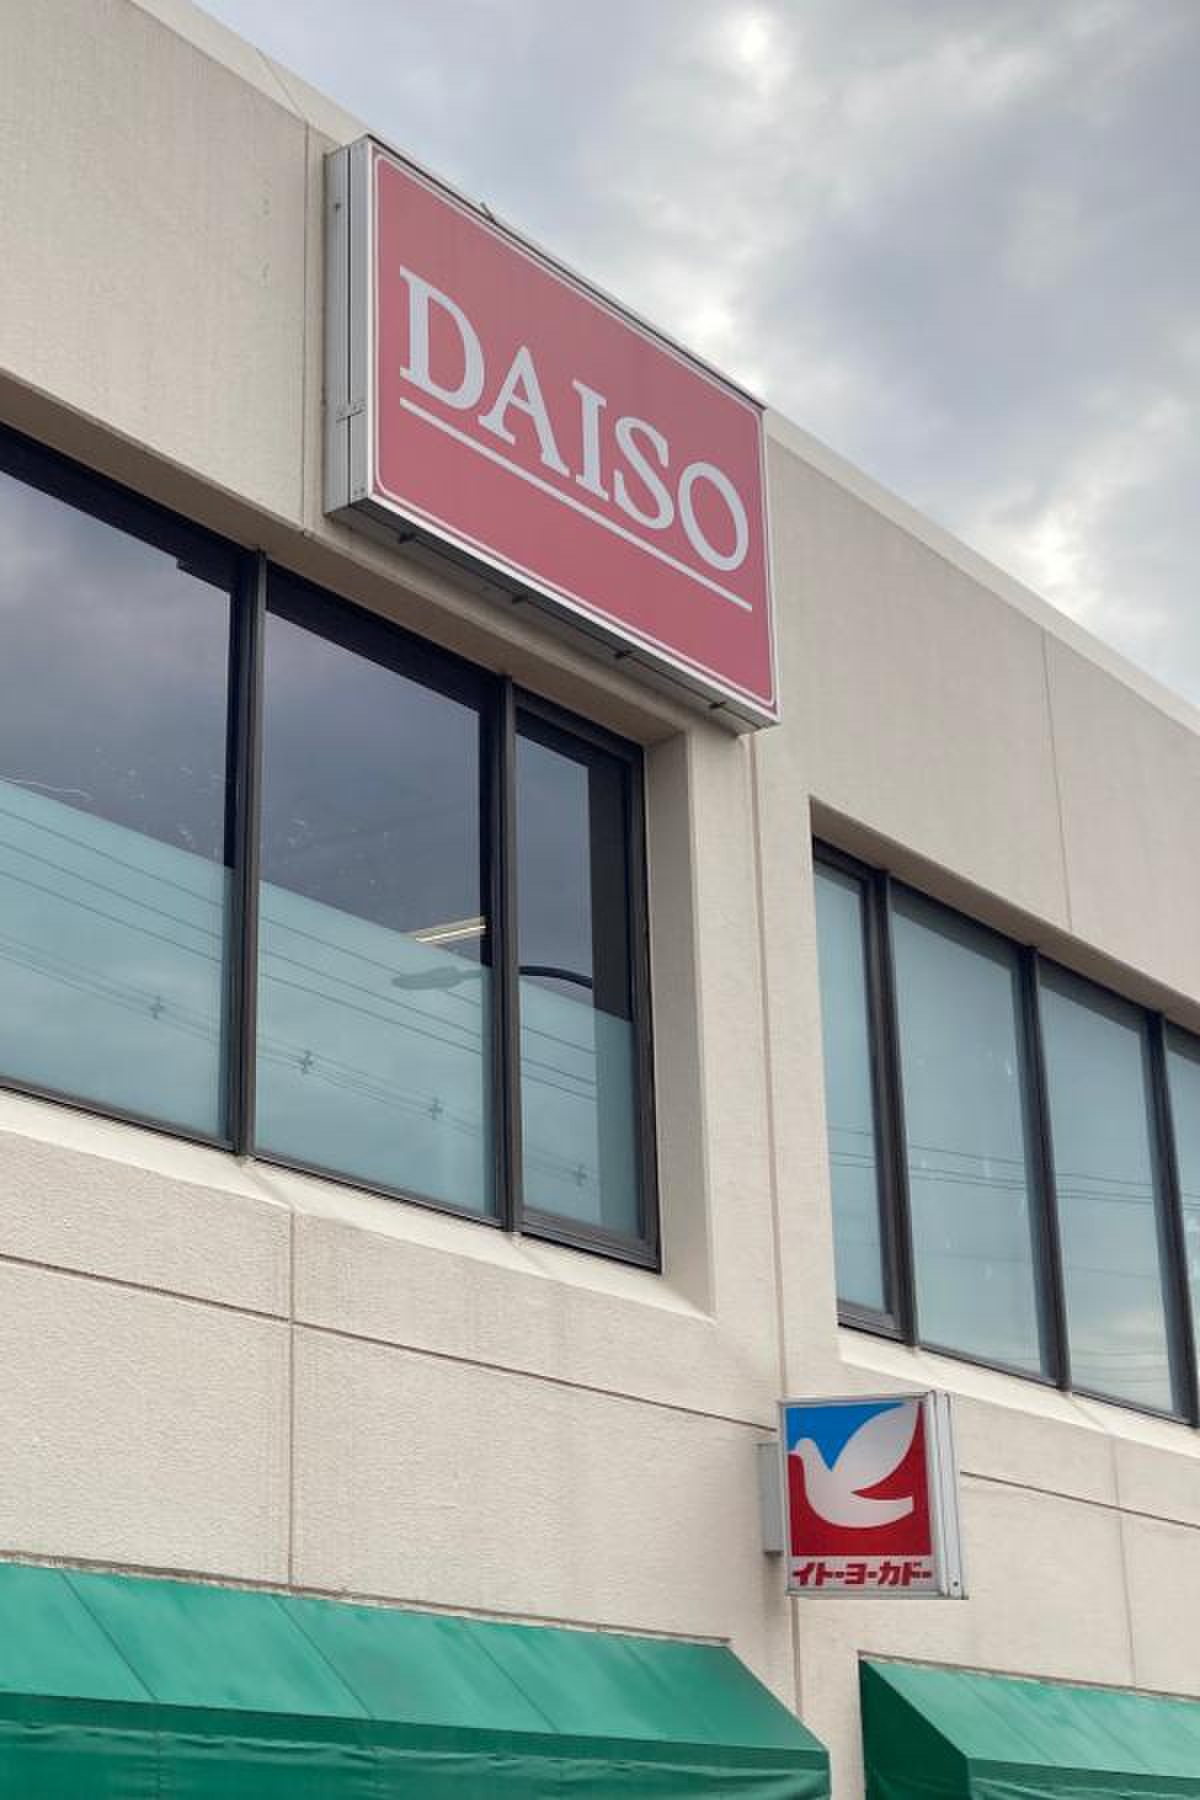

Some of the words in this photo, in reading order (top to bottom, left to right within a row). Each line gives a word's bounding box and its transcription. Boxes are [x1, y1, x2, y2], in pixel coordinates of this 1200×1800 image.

[399, 264, 749, 572] DAISO
[792, 1561, 932, 1587] イトーヨーカドー
